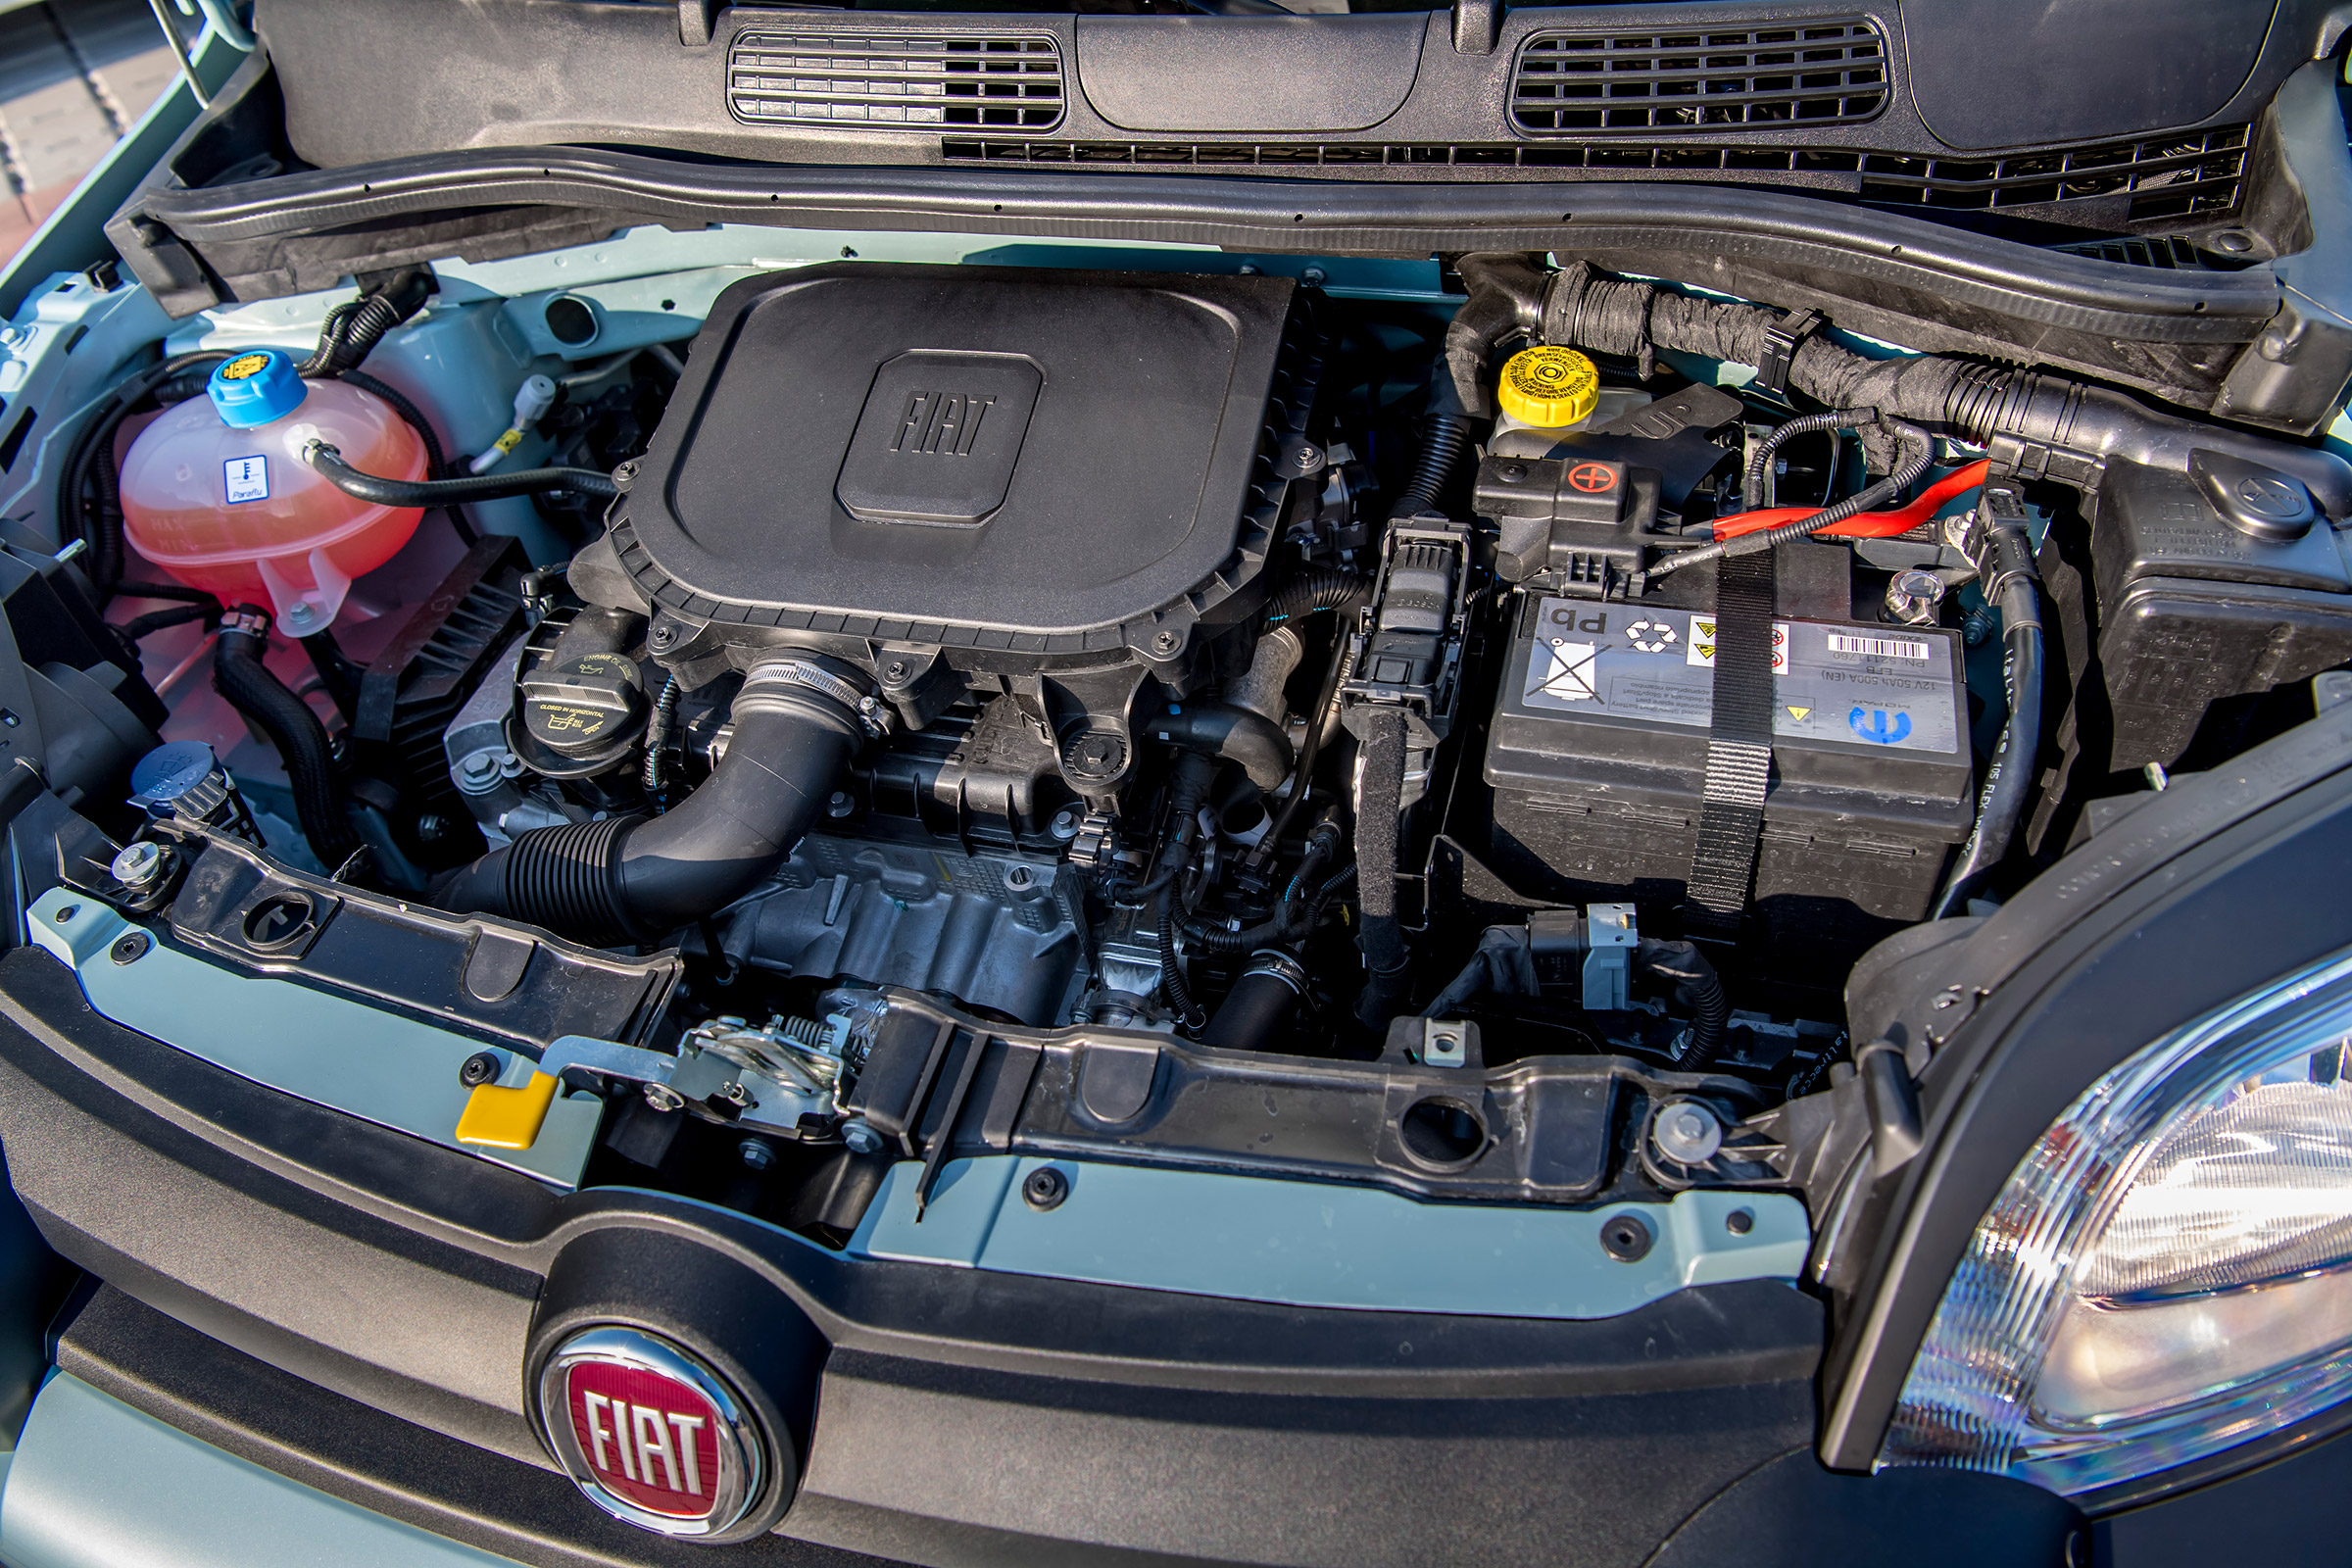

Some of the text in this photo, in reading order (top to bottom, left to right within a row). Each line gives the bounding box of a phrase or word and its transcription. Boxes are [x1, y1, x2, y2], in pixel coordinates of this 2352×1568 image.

[889, 391, 998, 456] FIAT
[1551, 608, 1607, 634] Pb
[584, 654, 612, 662] ENGINE
[1833, 652, 1897, 665] 52111760
[1866, 666, 1893, 675] EFB
[1821, 669, 1936, 690] 12V 50Ah 500A (EN)
[1623, 688, 1662, 698] Stop/Start
[1611, 700, 1638, 709] battery
[569, 708, 604, 718] HORIZONTAL
[584, 725, 600, 735] OPEN
[1989, 762, 2003, 780] 105
[1978, 784, 1996, 809] FLEX
[584, 1390, 706, 1496] FIAT
